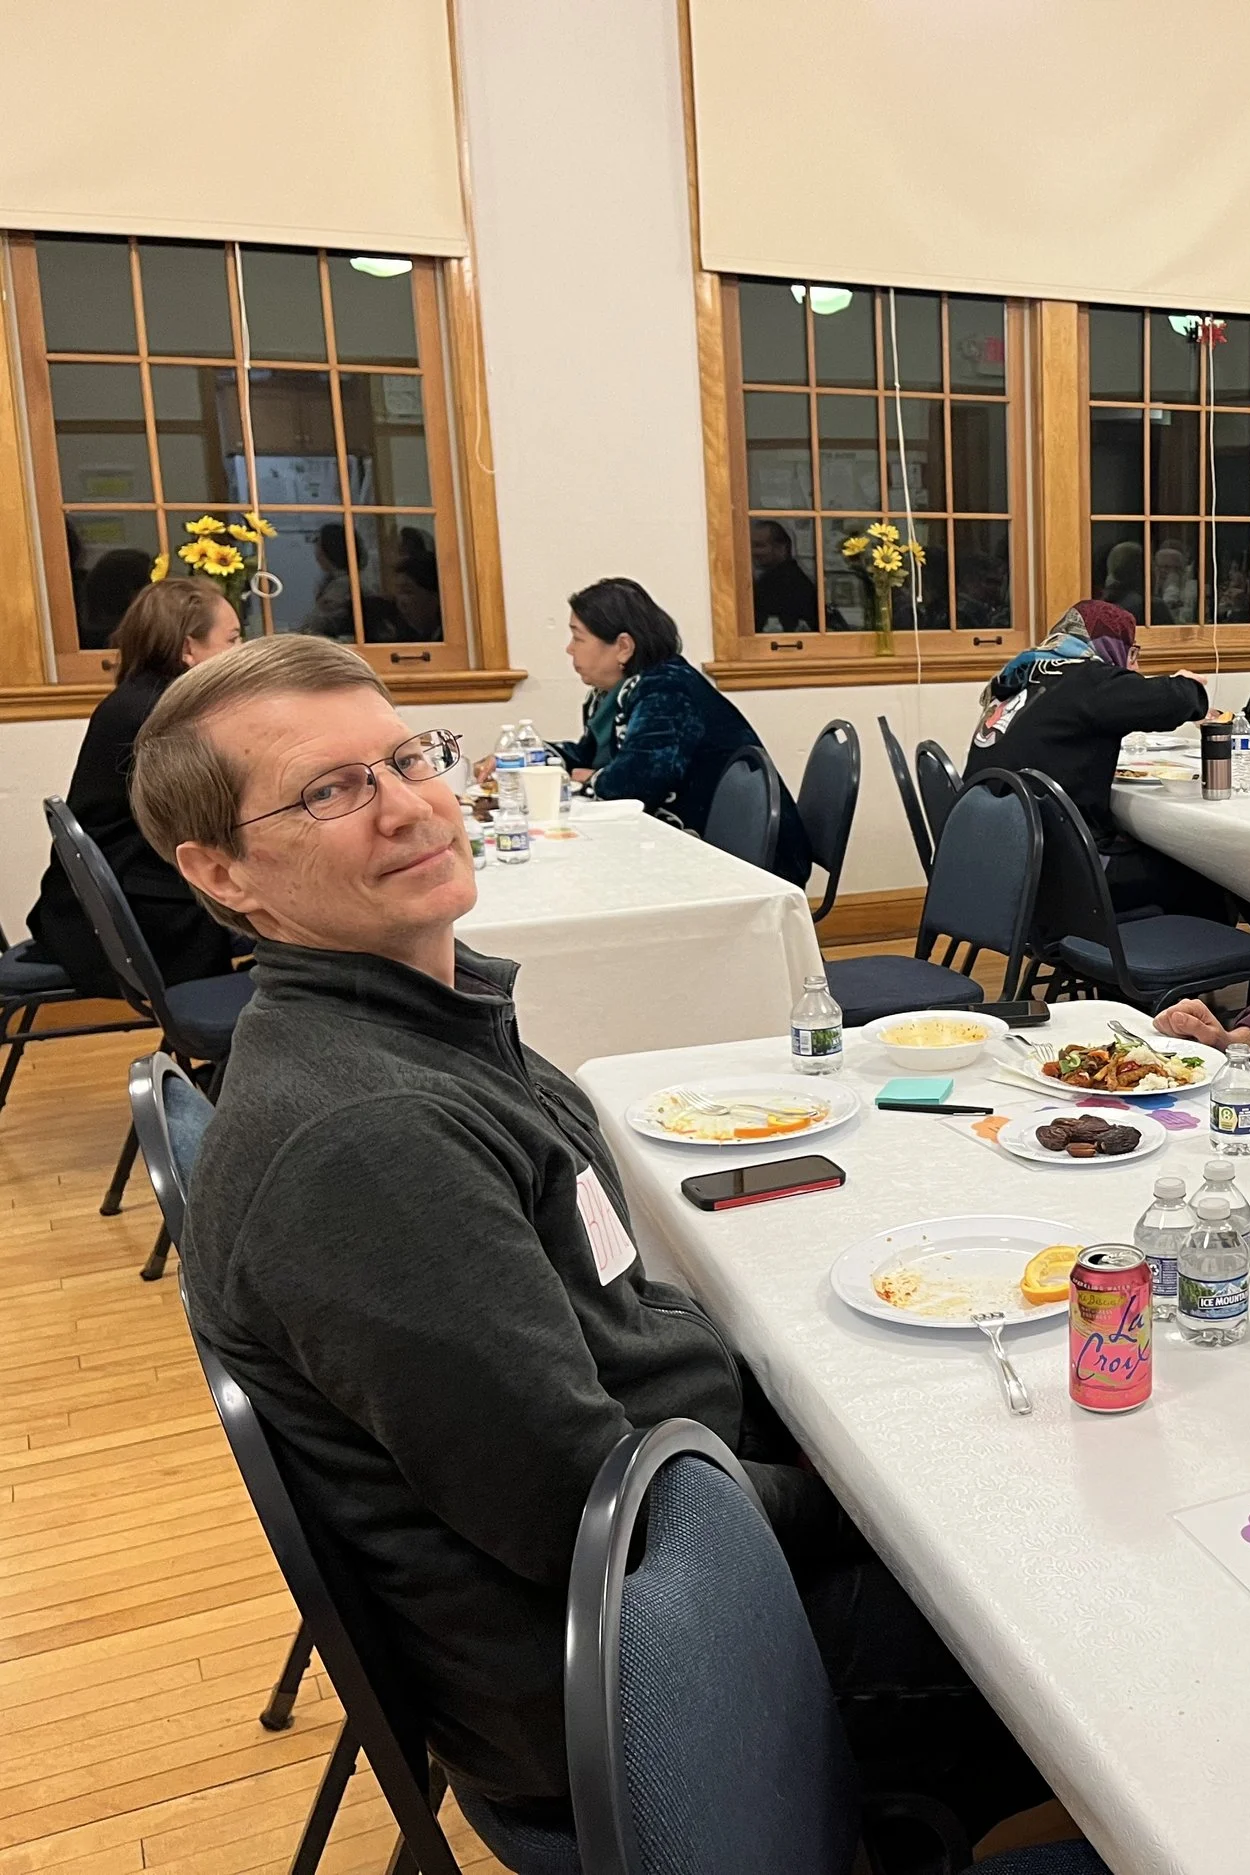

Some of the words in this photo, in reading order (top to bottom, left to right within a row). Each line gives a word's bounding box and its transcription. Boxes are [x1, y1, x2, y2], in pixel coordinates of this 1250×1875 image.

[1109, 1295, 1144, 1343] La
[1200, 1298, 1214, 1307] ICE
[1076, 1333, 1150, 1380] Croix
